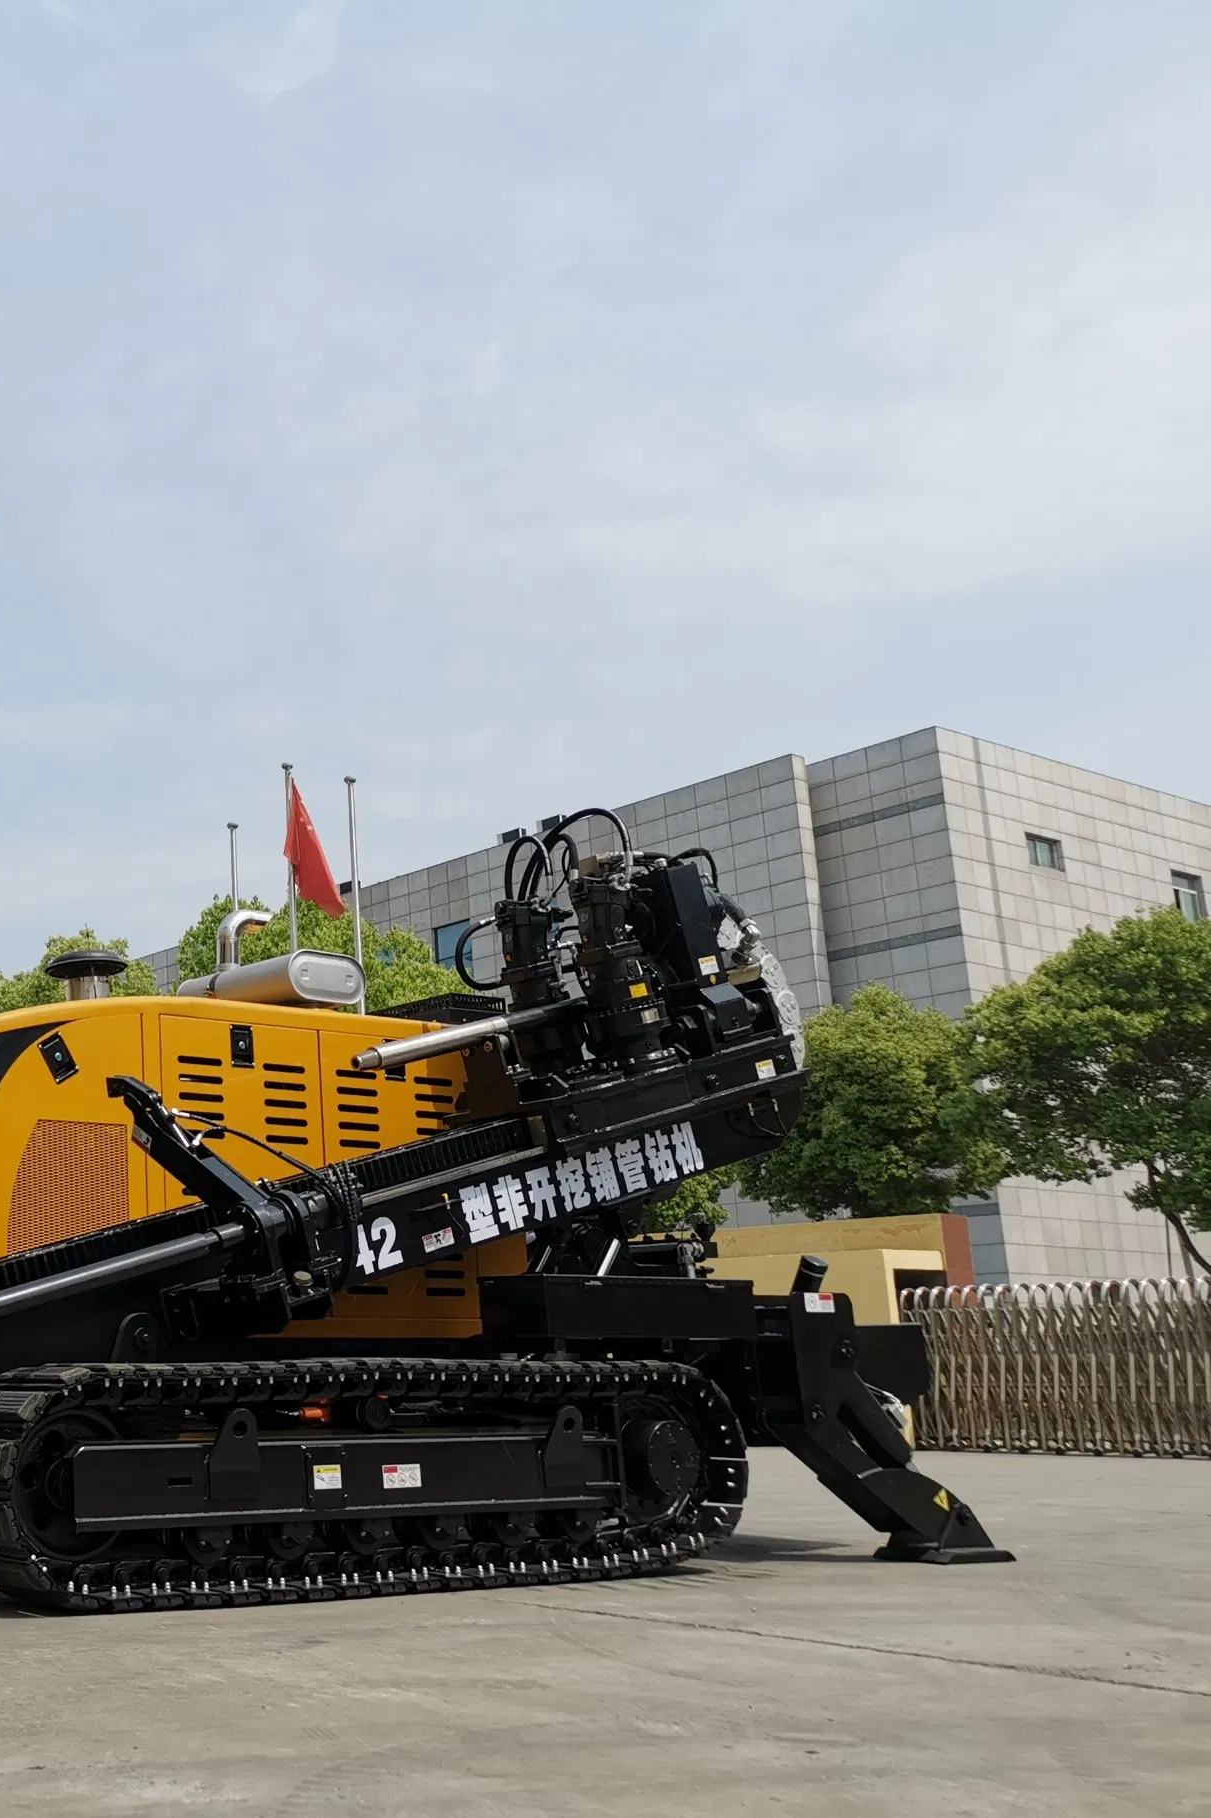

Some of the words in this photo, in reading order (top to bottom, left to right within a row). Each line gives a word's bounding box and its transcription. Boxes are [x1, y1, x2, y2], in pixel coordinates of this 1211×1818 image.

[459, 1122, 704, 1244] 型非开挖铺管钻机
